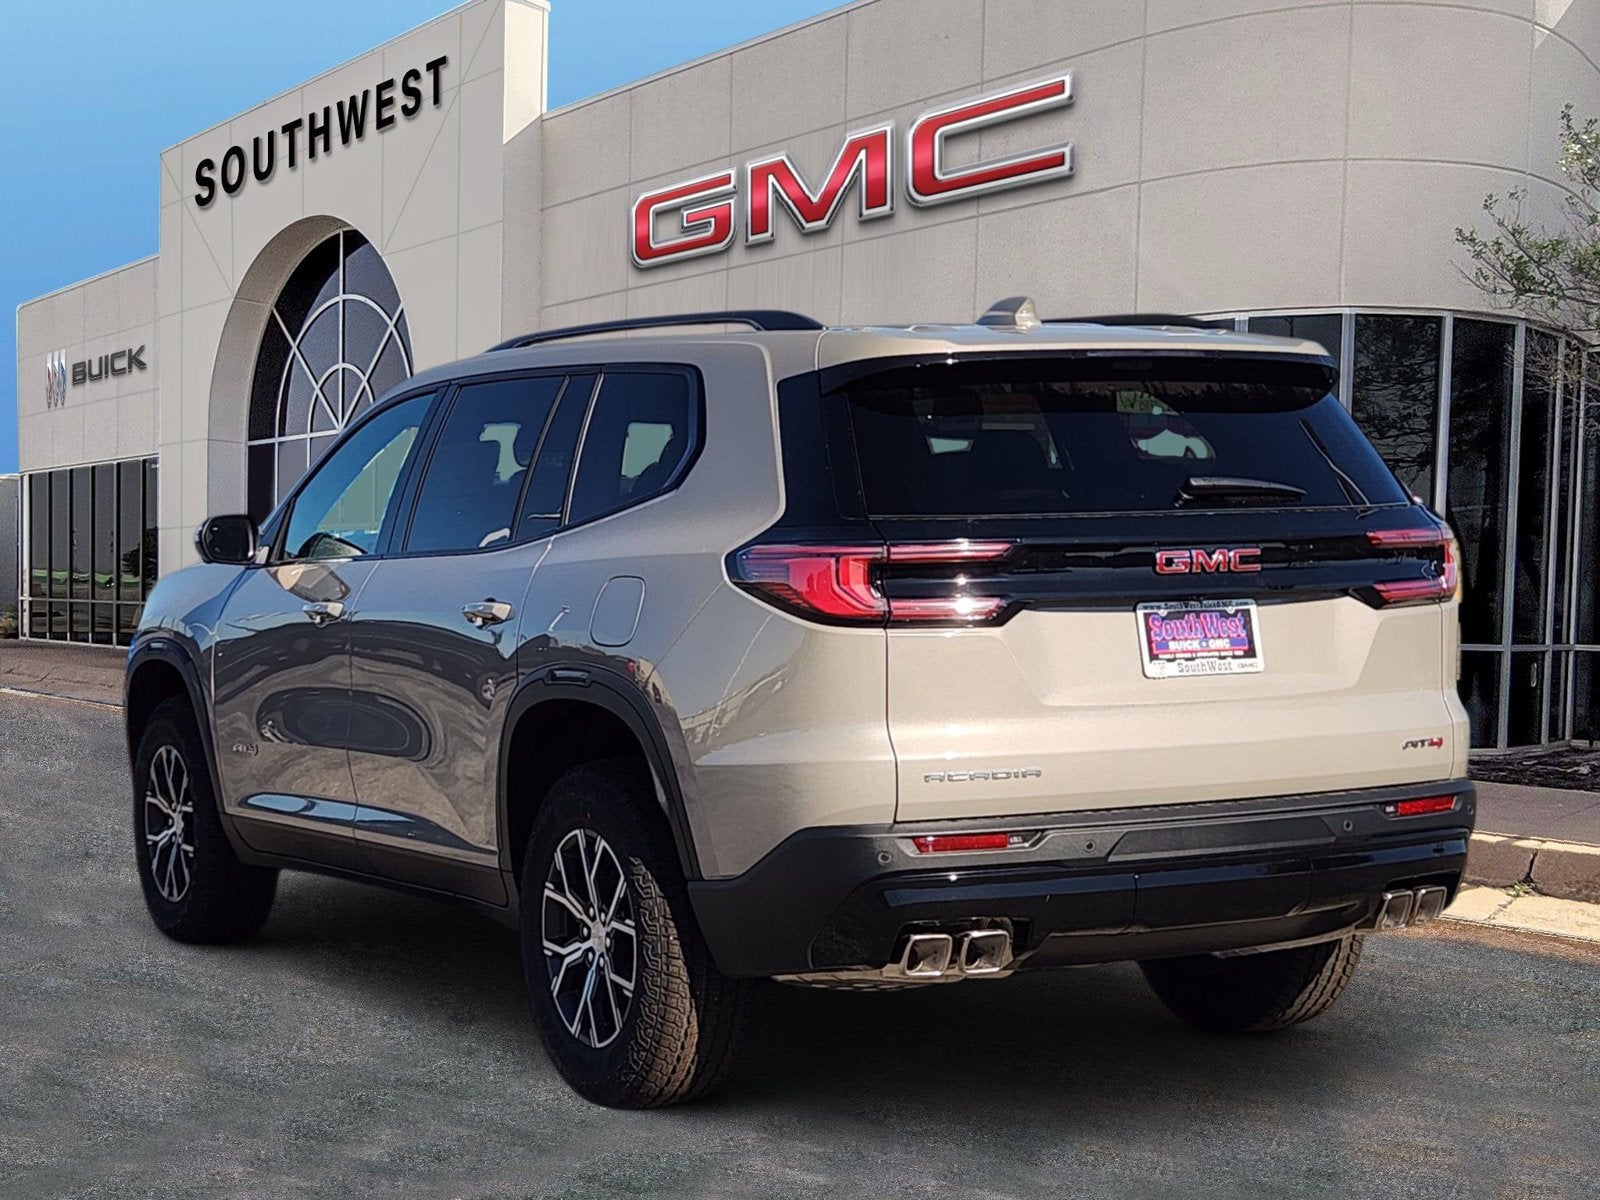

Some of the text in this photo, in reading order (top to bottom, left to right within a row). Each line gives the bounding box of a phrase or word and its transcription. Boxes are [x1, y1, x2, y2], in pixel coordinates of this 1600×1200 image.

[194, 55, 449, 208] SOUTHWEST
[630, 67, 1075, 269] GMC
[71, 344, 147, 385] BUICK
[1155, 548, 1261, 574] GMC
[1149, 611, 1247, 641] SouthWest
[1168, 638, 1231, 651] BUICK GMC
[1177, 659, 1233, 674] SouthWest
[1401, 736, 1444, 751] AT4
[924, 768, 1042, 784] ACADIA
